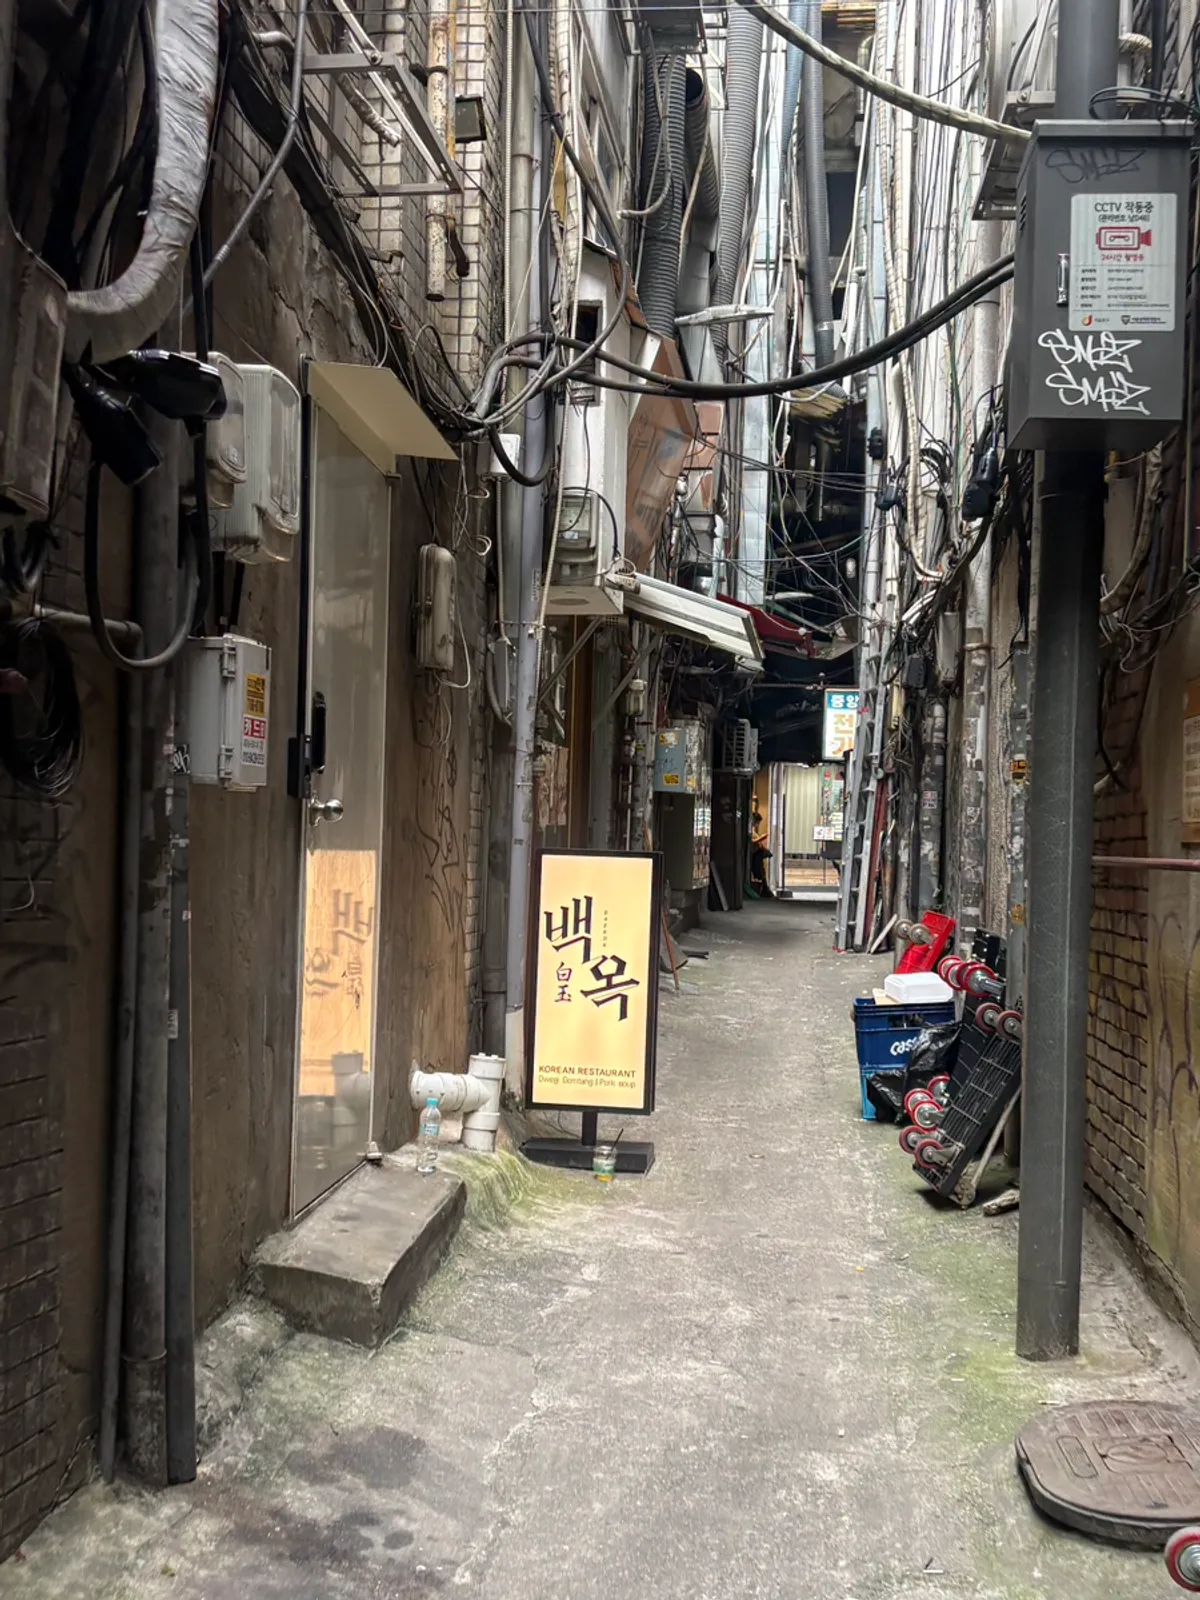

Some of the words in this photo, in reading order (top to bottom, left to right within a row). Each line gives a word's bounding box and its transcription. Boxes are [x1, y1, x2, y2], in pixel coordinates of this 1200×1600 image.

[1094, 202, 1122, 212] CCTV
[1124, 201, 1154, 213] 작동중
[830, 695, 860, 708] 중앙
[544, 895, 640, 1021] 백옥
[554, 961, 572, 1002] 白玉
[539, 1065, 575, 1075] KOREAN
[577, 1067, 636, 1078] RESTAURANT
[599, 1078, 615, 1087] Pork
